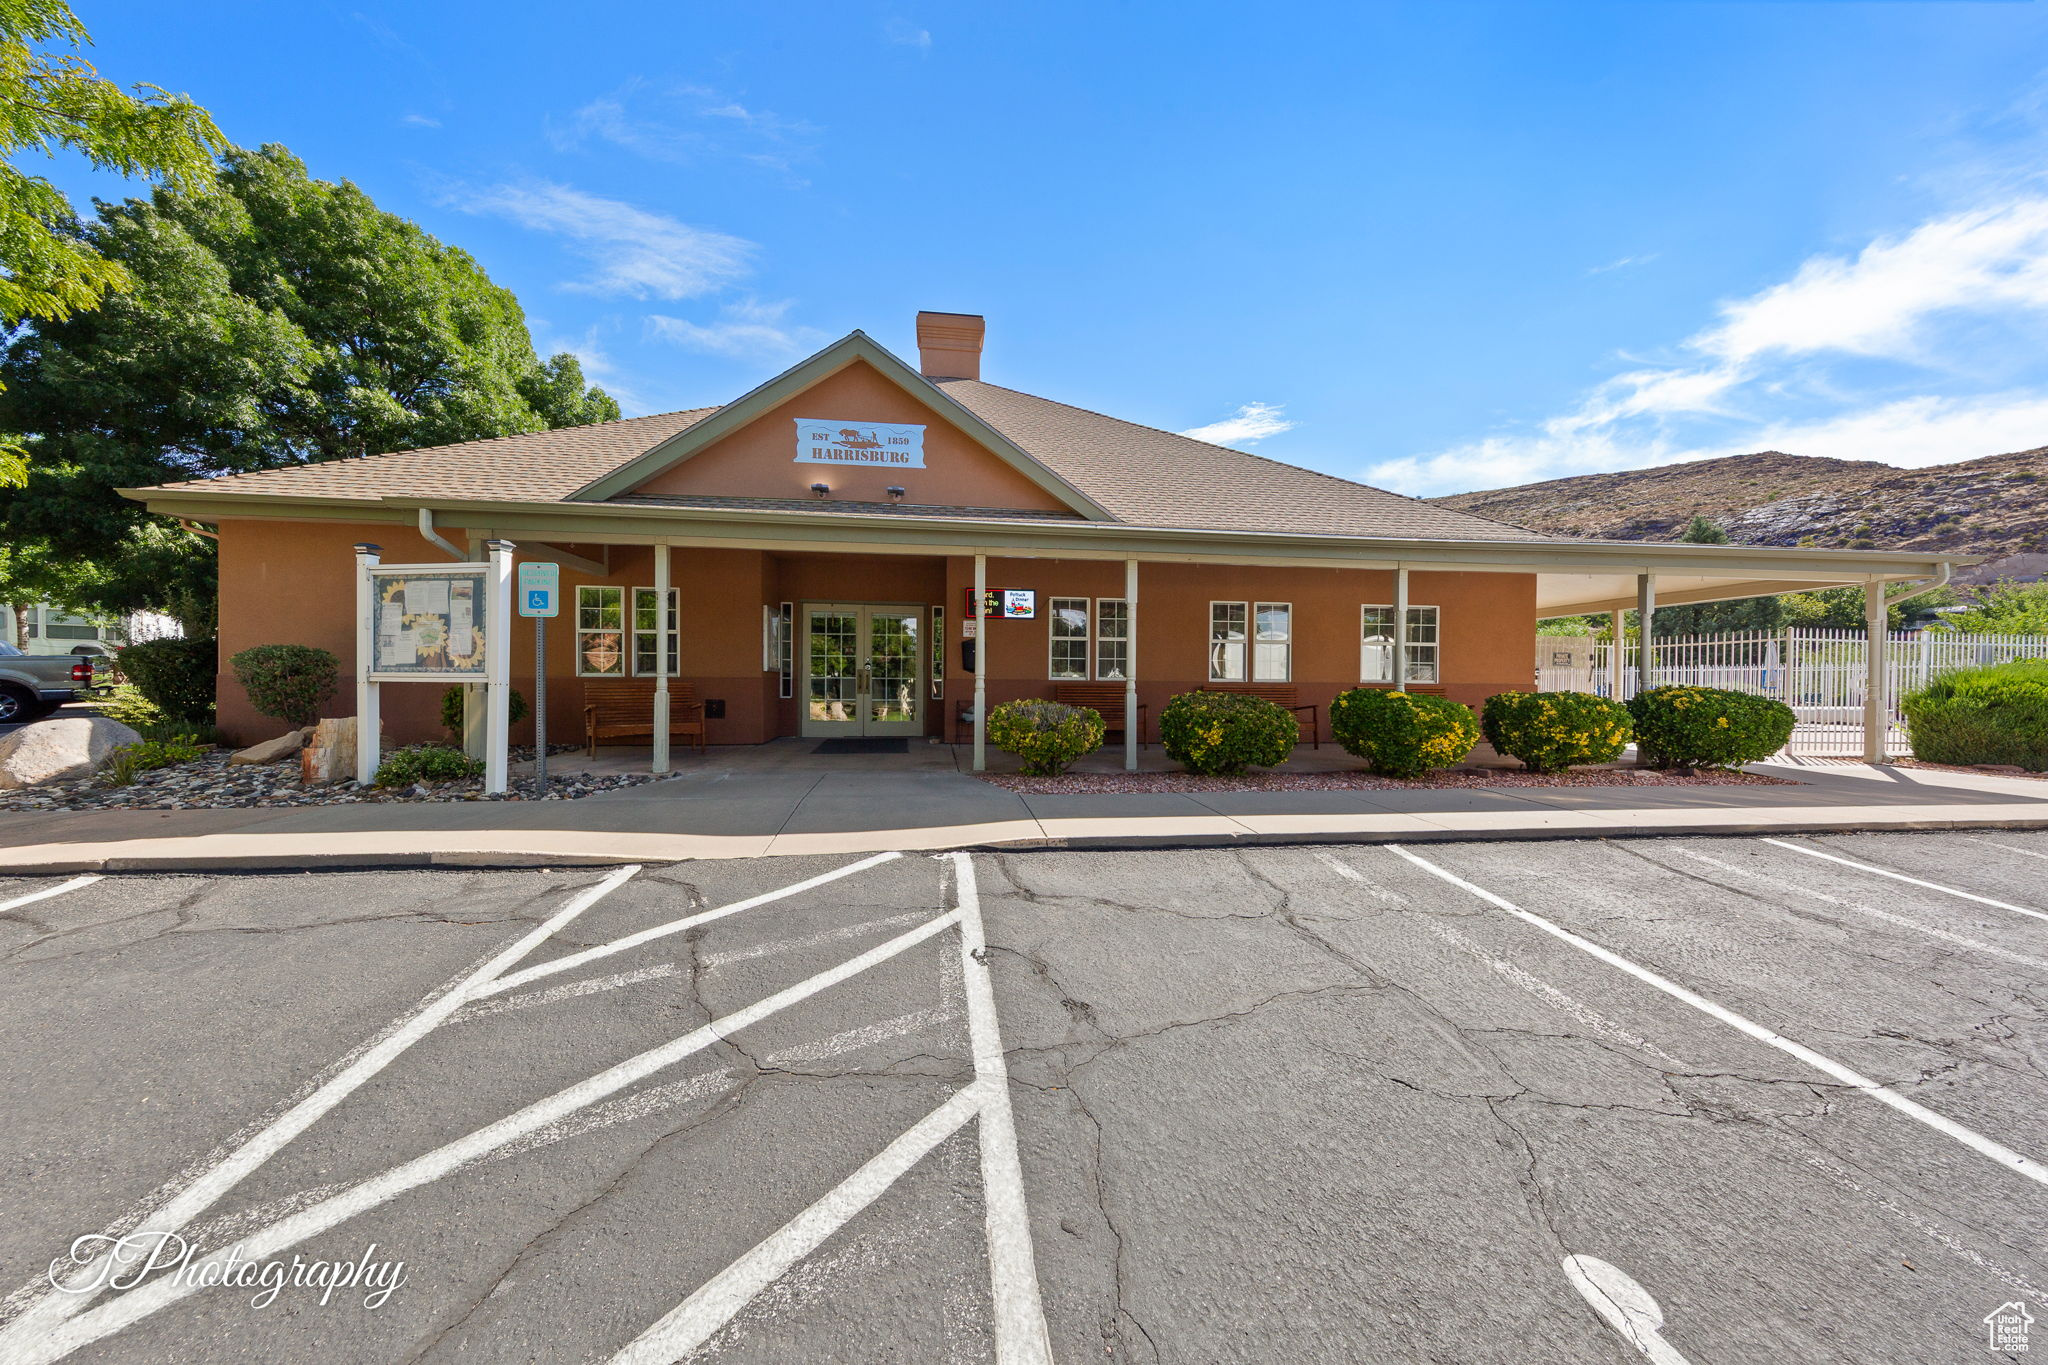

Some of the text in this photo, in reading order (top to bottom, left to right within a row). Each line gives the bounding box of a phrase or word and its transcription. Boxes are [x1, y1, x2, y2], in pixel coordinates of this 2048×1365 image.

[812, 433, 909, 445] EST 1859
[812, 447, 909, 464] HARRISBURG
